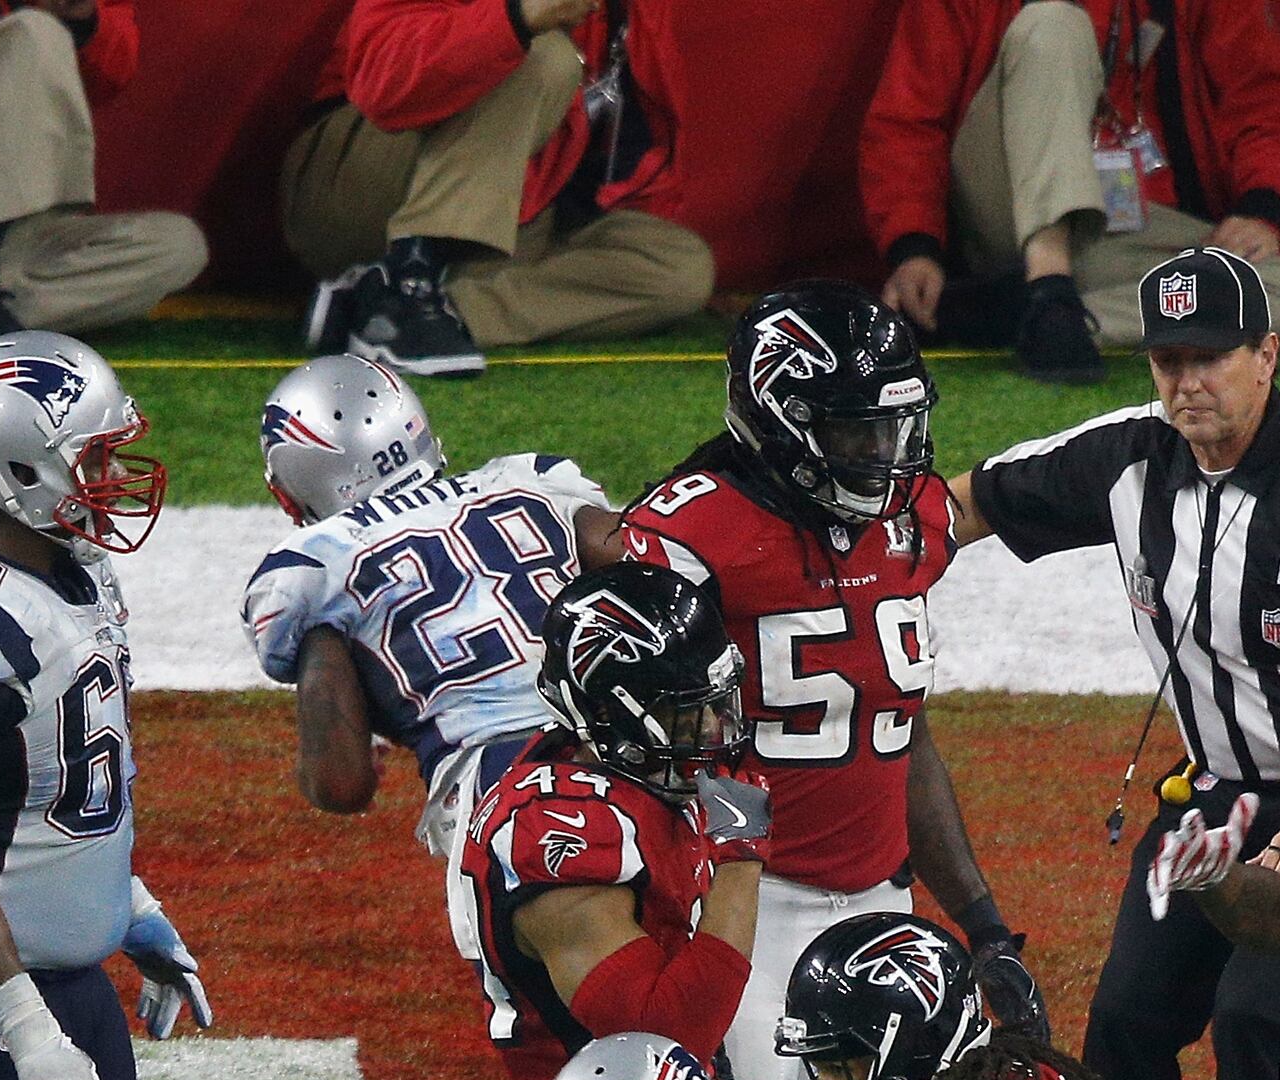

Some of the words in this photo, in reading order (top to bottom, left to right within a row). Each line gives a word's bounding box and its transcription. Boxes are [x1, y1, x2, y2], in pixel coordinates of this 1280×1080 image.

[372, 440, 409, 477] 28
[344, 487, 581, 713] 28
[754, 593, 936, 759] 59
[45, 643, 131, 839] 6
[515, 765, 613, 797] 44
